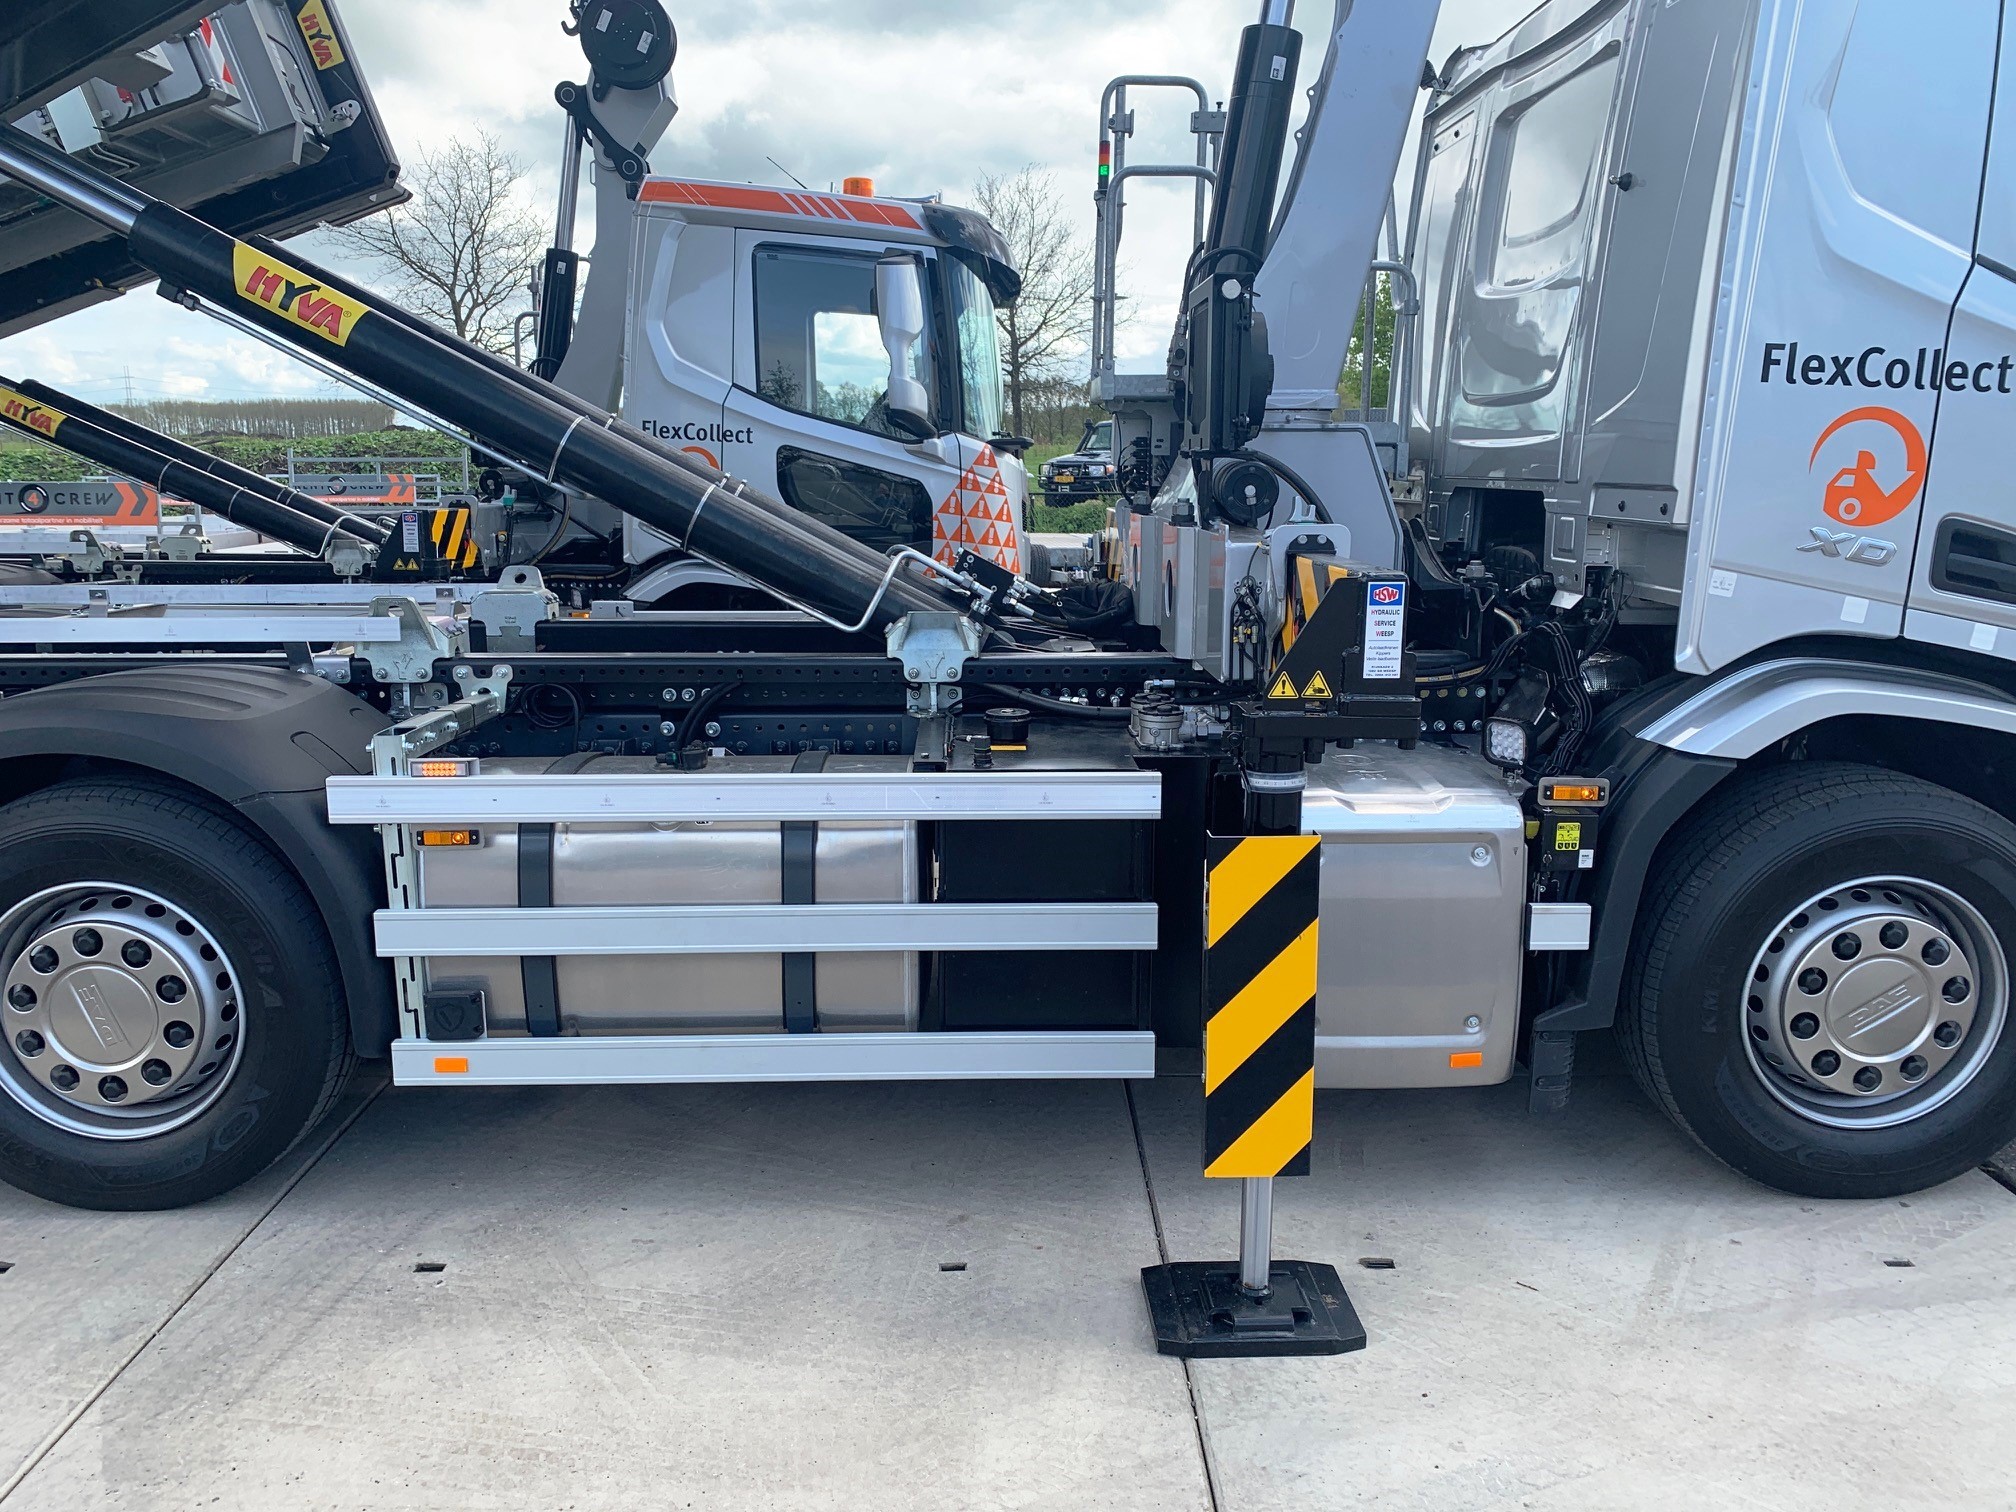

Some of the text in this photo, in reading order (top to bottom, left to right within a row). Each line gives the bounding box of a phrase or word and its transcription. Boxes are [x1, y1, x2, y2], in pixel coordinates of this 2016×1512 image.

[301, 13, 333, 67] HYVA
[245, 265, 344, 338] HYVA
[1760, 341, 2015, 394] FlexCollect
[4, 399, 53, 433] HYVA
[642, 420, 754, 444] FlexCollect
[27, 492, 39, 505] 4
[54, 492, 114, 505] CREW
[73, 516, 104, 524] mobiliteit
[1796, 526, 1898, 567] XD
[1374, 587, 1398, 602] HSW
